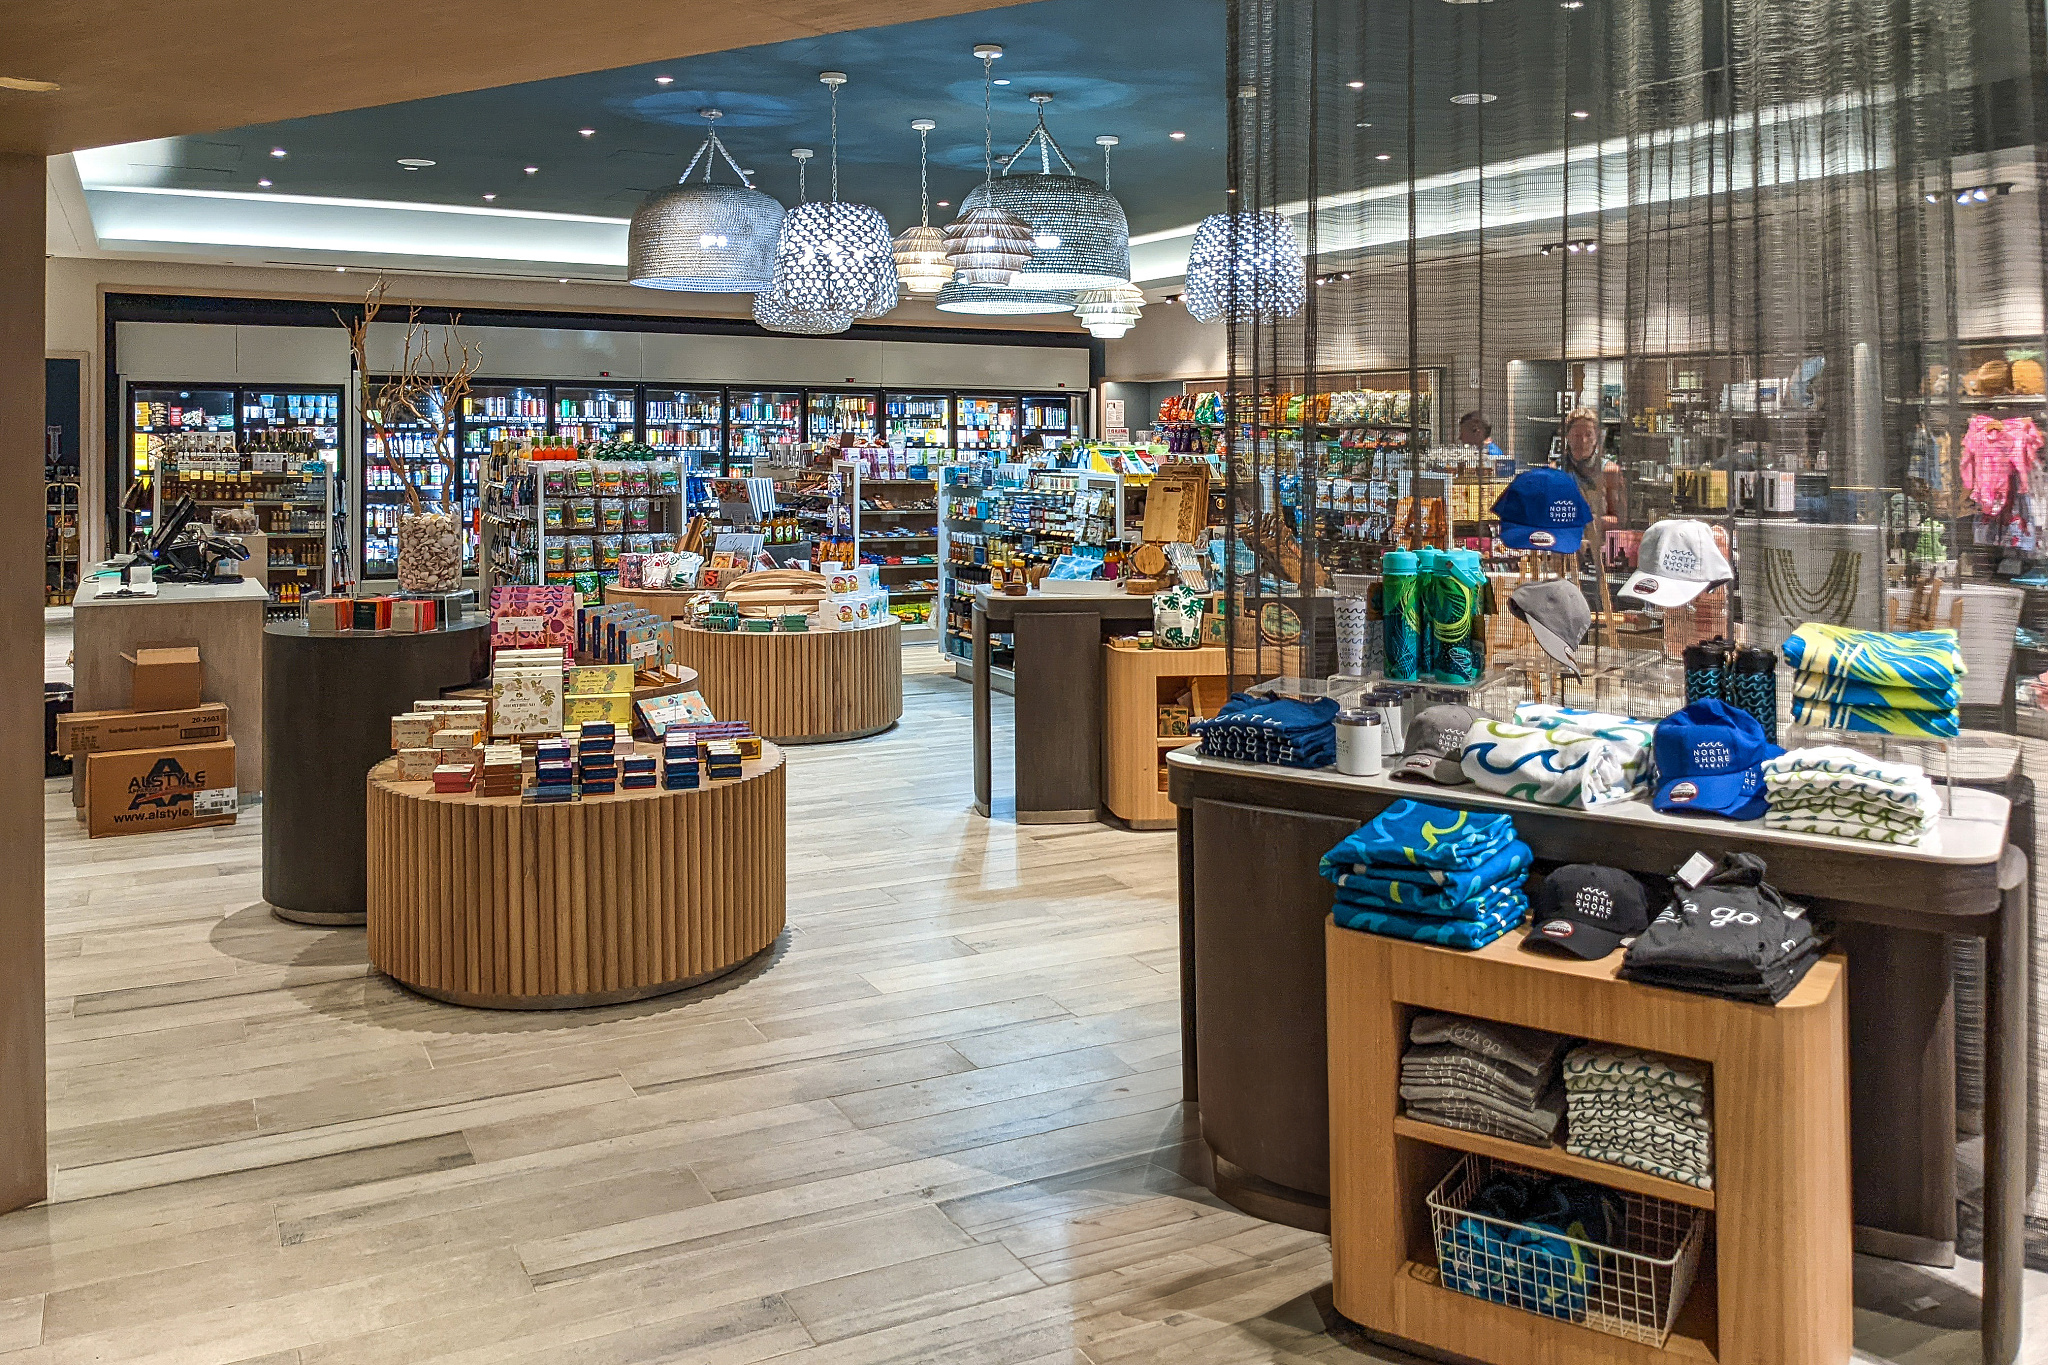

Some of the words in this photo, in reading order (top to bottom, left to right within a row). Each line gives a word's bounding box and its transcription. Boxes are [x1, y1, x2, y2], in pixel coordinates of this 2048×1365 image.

[1663, 560, 1696, 570] SHORE
[1664, 554, 1697, 564] NORTH
[1438, 739, 1462, 748] SHO
[1439, 733, 1464, 742] NORT
[1693, 748, 1729, 756] NORTH
[1694, 755, 1730, 763] SHORE
[128, 770, 206, 791] ALSTYLE
[114, 806, 194, 823] www.alstyle.
[1575, 892, 1613, 907] NORTH
[1575, 899, 1612, 915] SHORE
[1710, 907, 1762, 928] go
[1483, 1038, 1501, 1054] go
